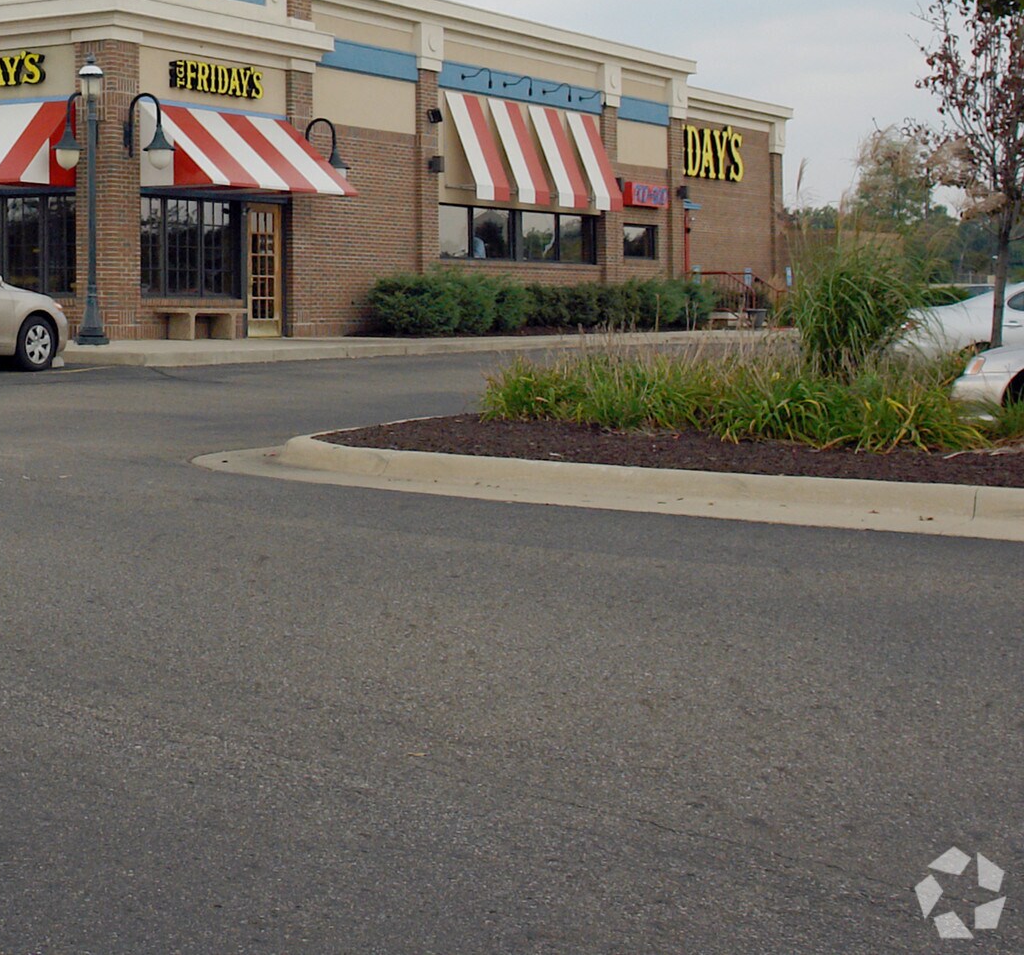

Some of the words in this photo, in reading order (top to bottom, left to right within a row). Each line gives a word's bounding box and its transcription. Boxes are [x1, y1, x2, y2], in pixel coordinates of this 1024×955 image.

[176, 60, 185, 88] TGI
[185, 60, 264, 100] FRIDAY'S
[682, 124, 744, 182] DAY'S
